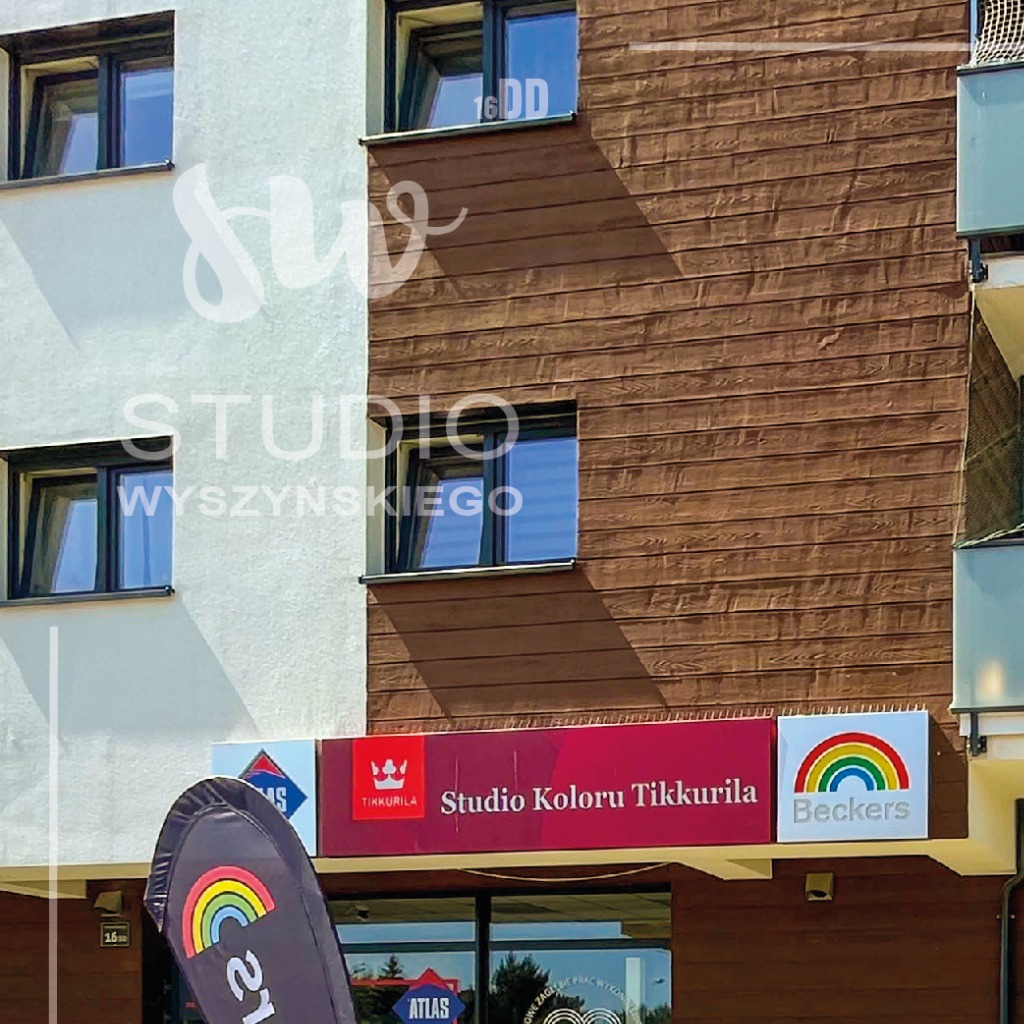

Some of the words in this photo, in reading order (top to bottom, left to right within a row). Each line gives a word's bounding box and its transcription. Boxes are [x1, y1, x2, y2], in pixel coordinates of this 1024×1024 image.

[361, 795, 418, 808] TIKKURILA
[441, 786, 525, 815] Studio
[532, 784, 625, 811] Koloru
[631, 778, 758, 807] Tikkurila
[793, 797, 910, 824] Beckers
[409, 998, 449, 1019] ATLAS
